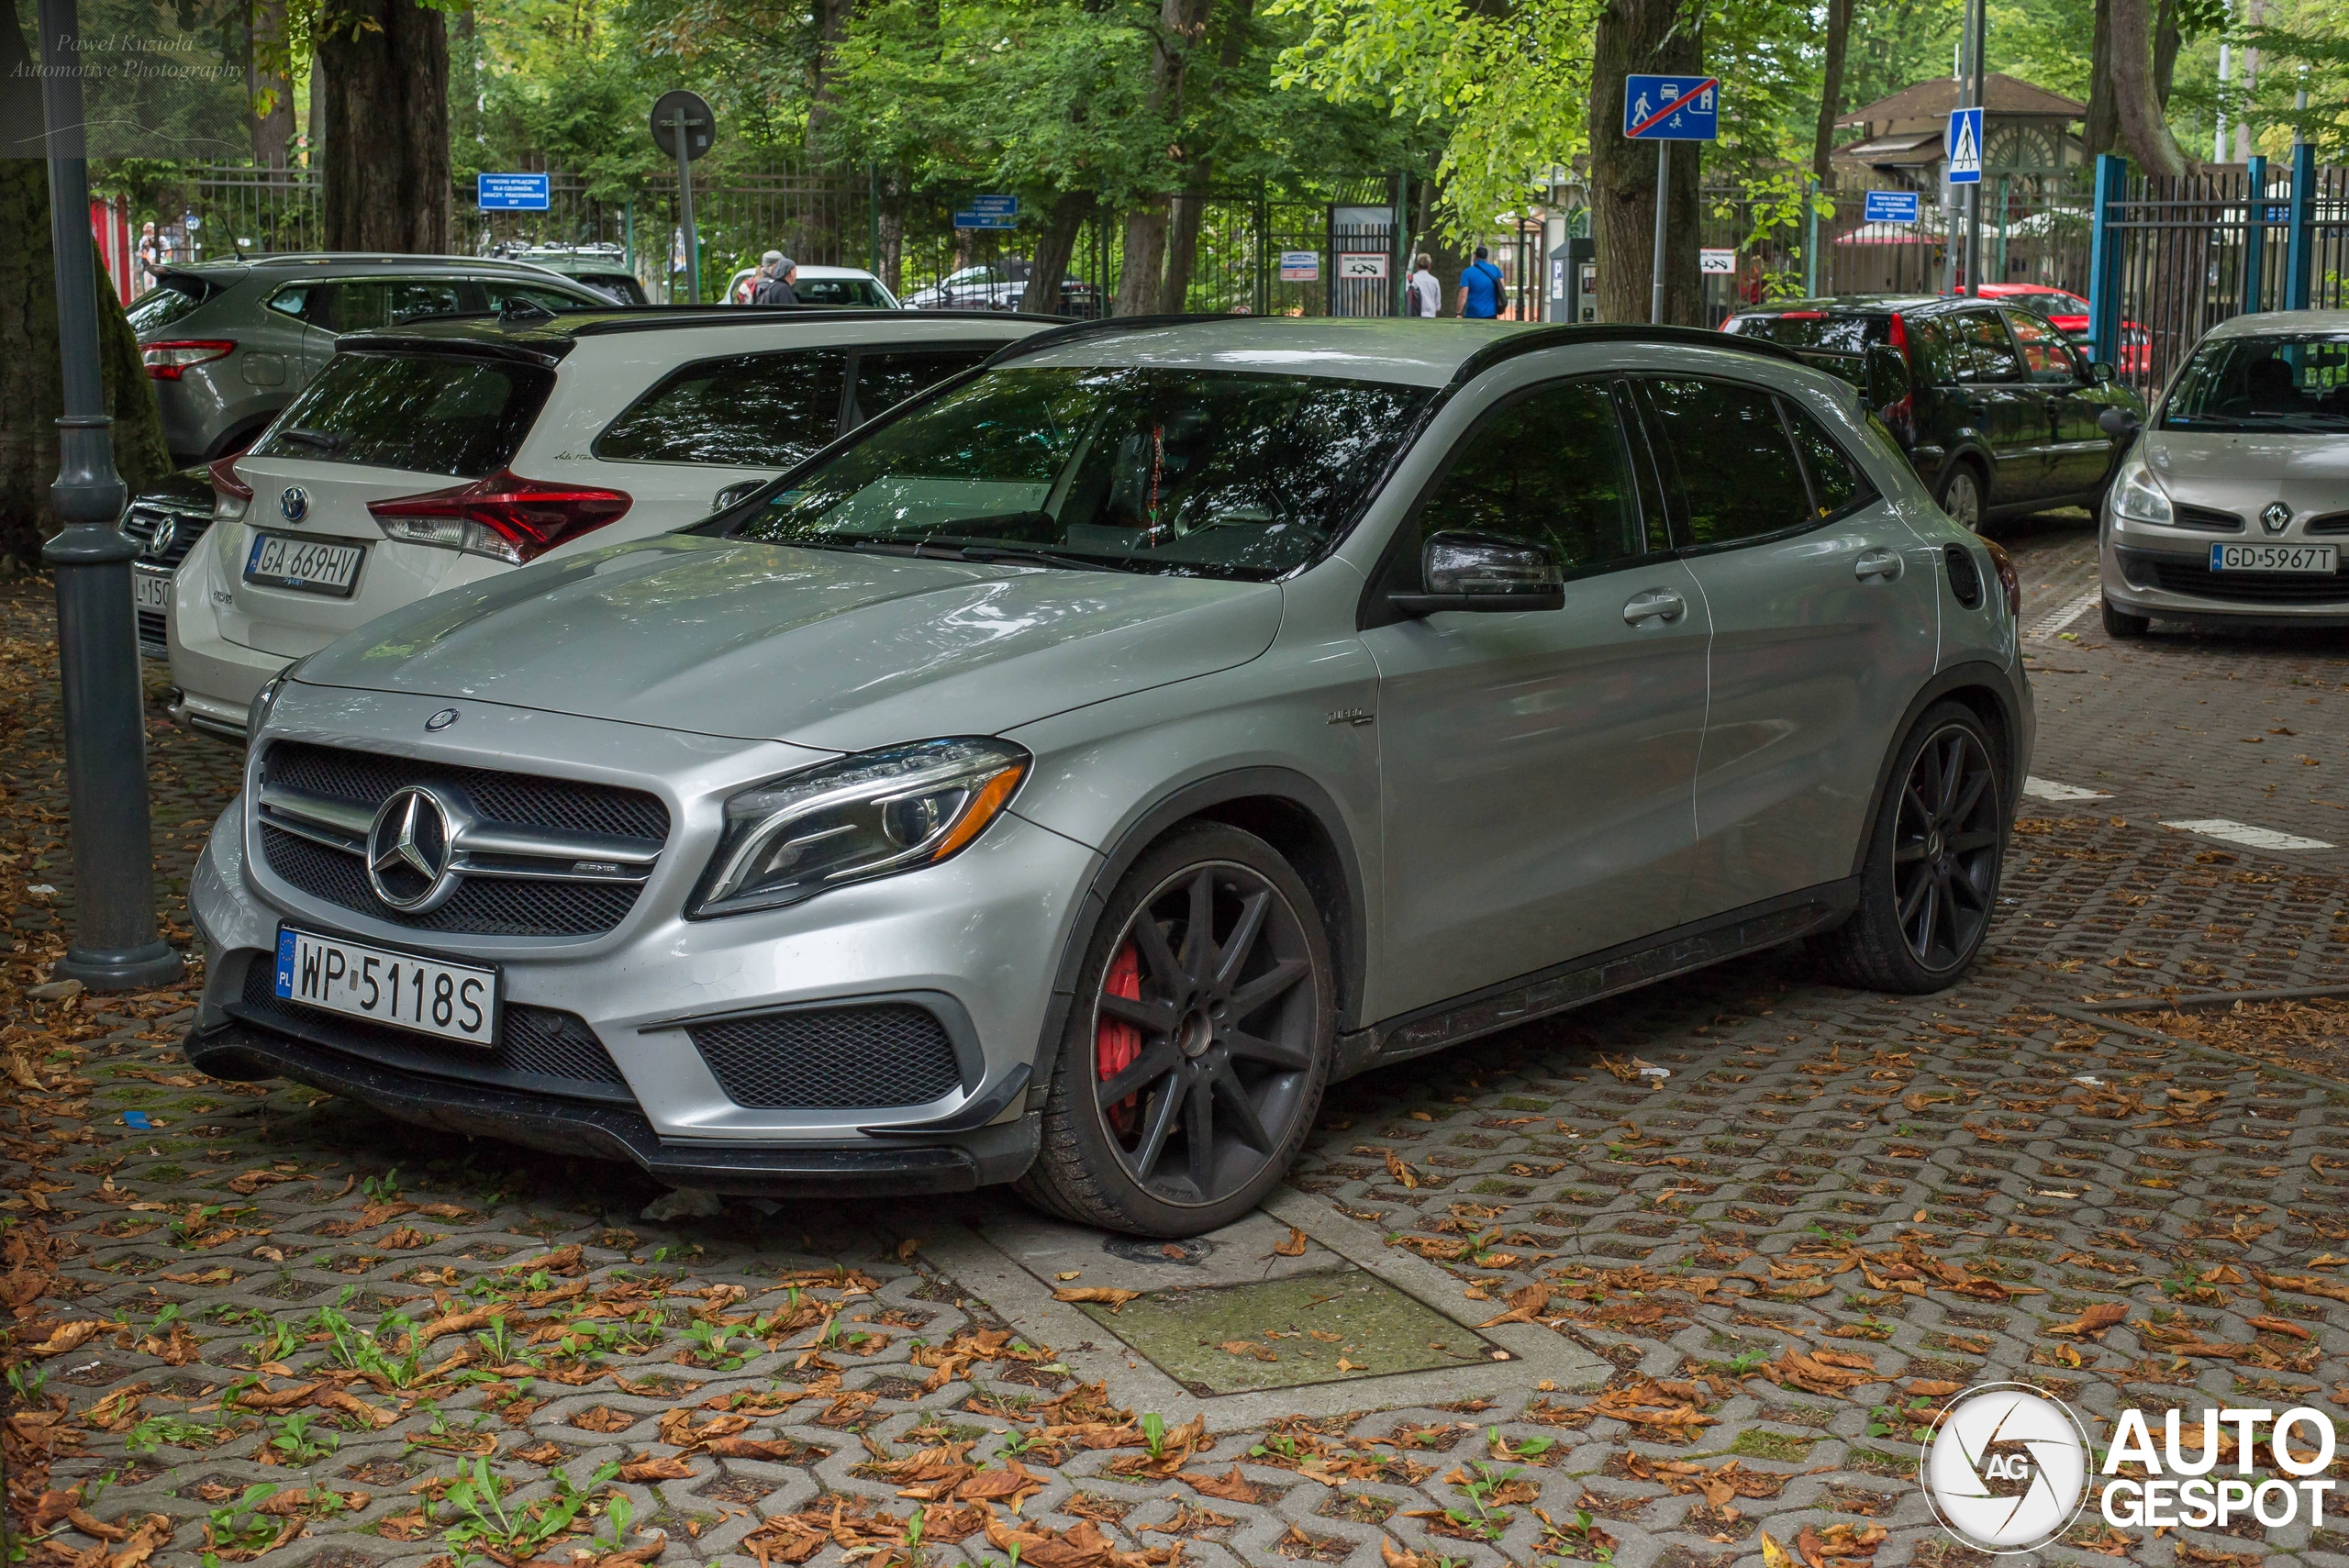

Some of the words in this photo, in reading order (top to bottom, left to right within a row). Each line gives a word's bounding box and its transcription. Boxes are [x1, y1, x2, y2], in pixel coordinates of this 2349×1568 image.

[261, 539, 287, 574] GA
[289, 543, 356, 584] 669HV
[2225, 547, 2255, 567] GD
[2264, 548, 2332, 569] 5967T
[278, 971, 291, 988] PL
[301, 941, 347, 1002] WP
[360, 955, 486, 1034] 5118S
